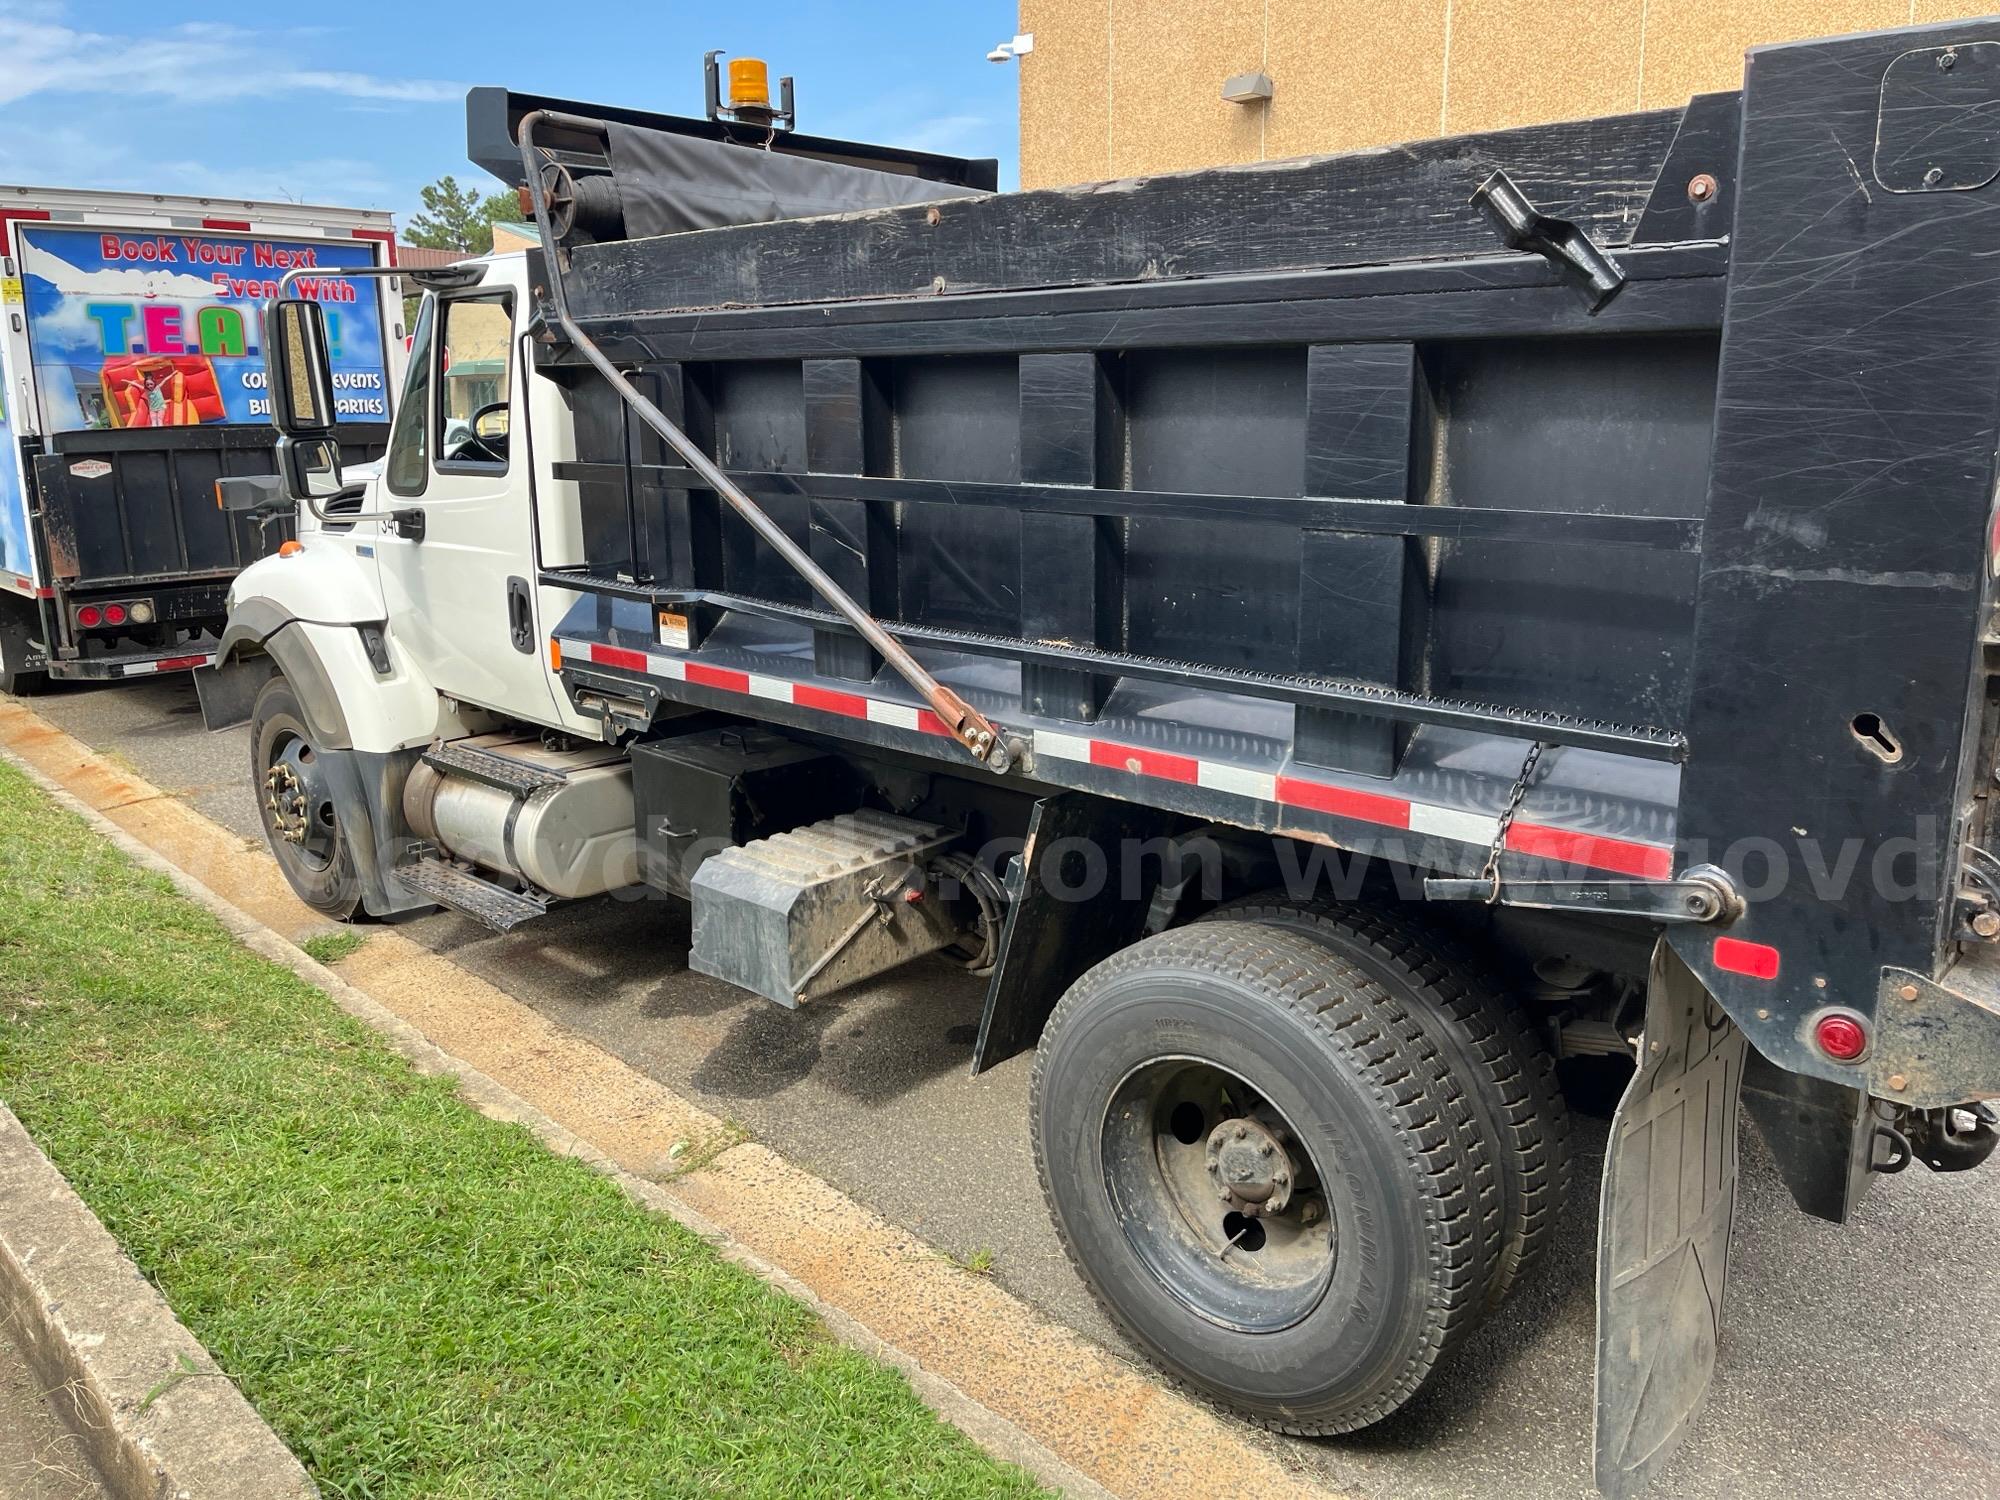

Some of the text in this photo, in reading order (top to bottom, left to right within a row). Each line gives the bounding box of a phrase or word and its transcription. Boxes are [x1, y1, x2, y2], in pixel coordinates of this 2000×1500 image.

[101, 235, 317, 268] Book Your Next
[212, 272, 356, 302] Even With
[332, 373, 381, 389] EVENTS
